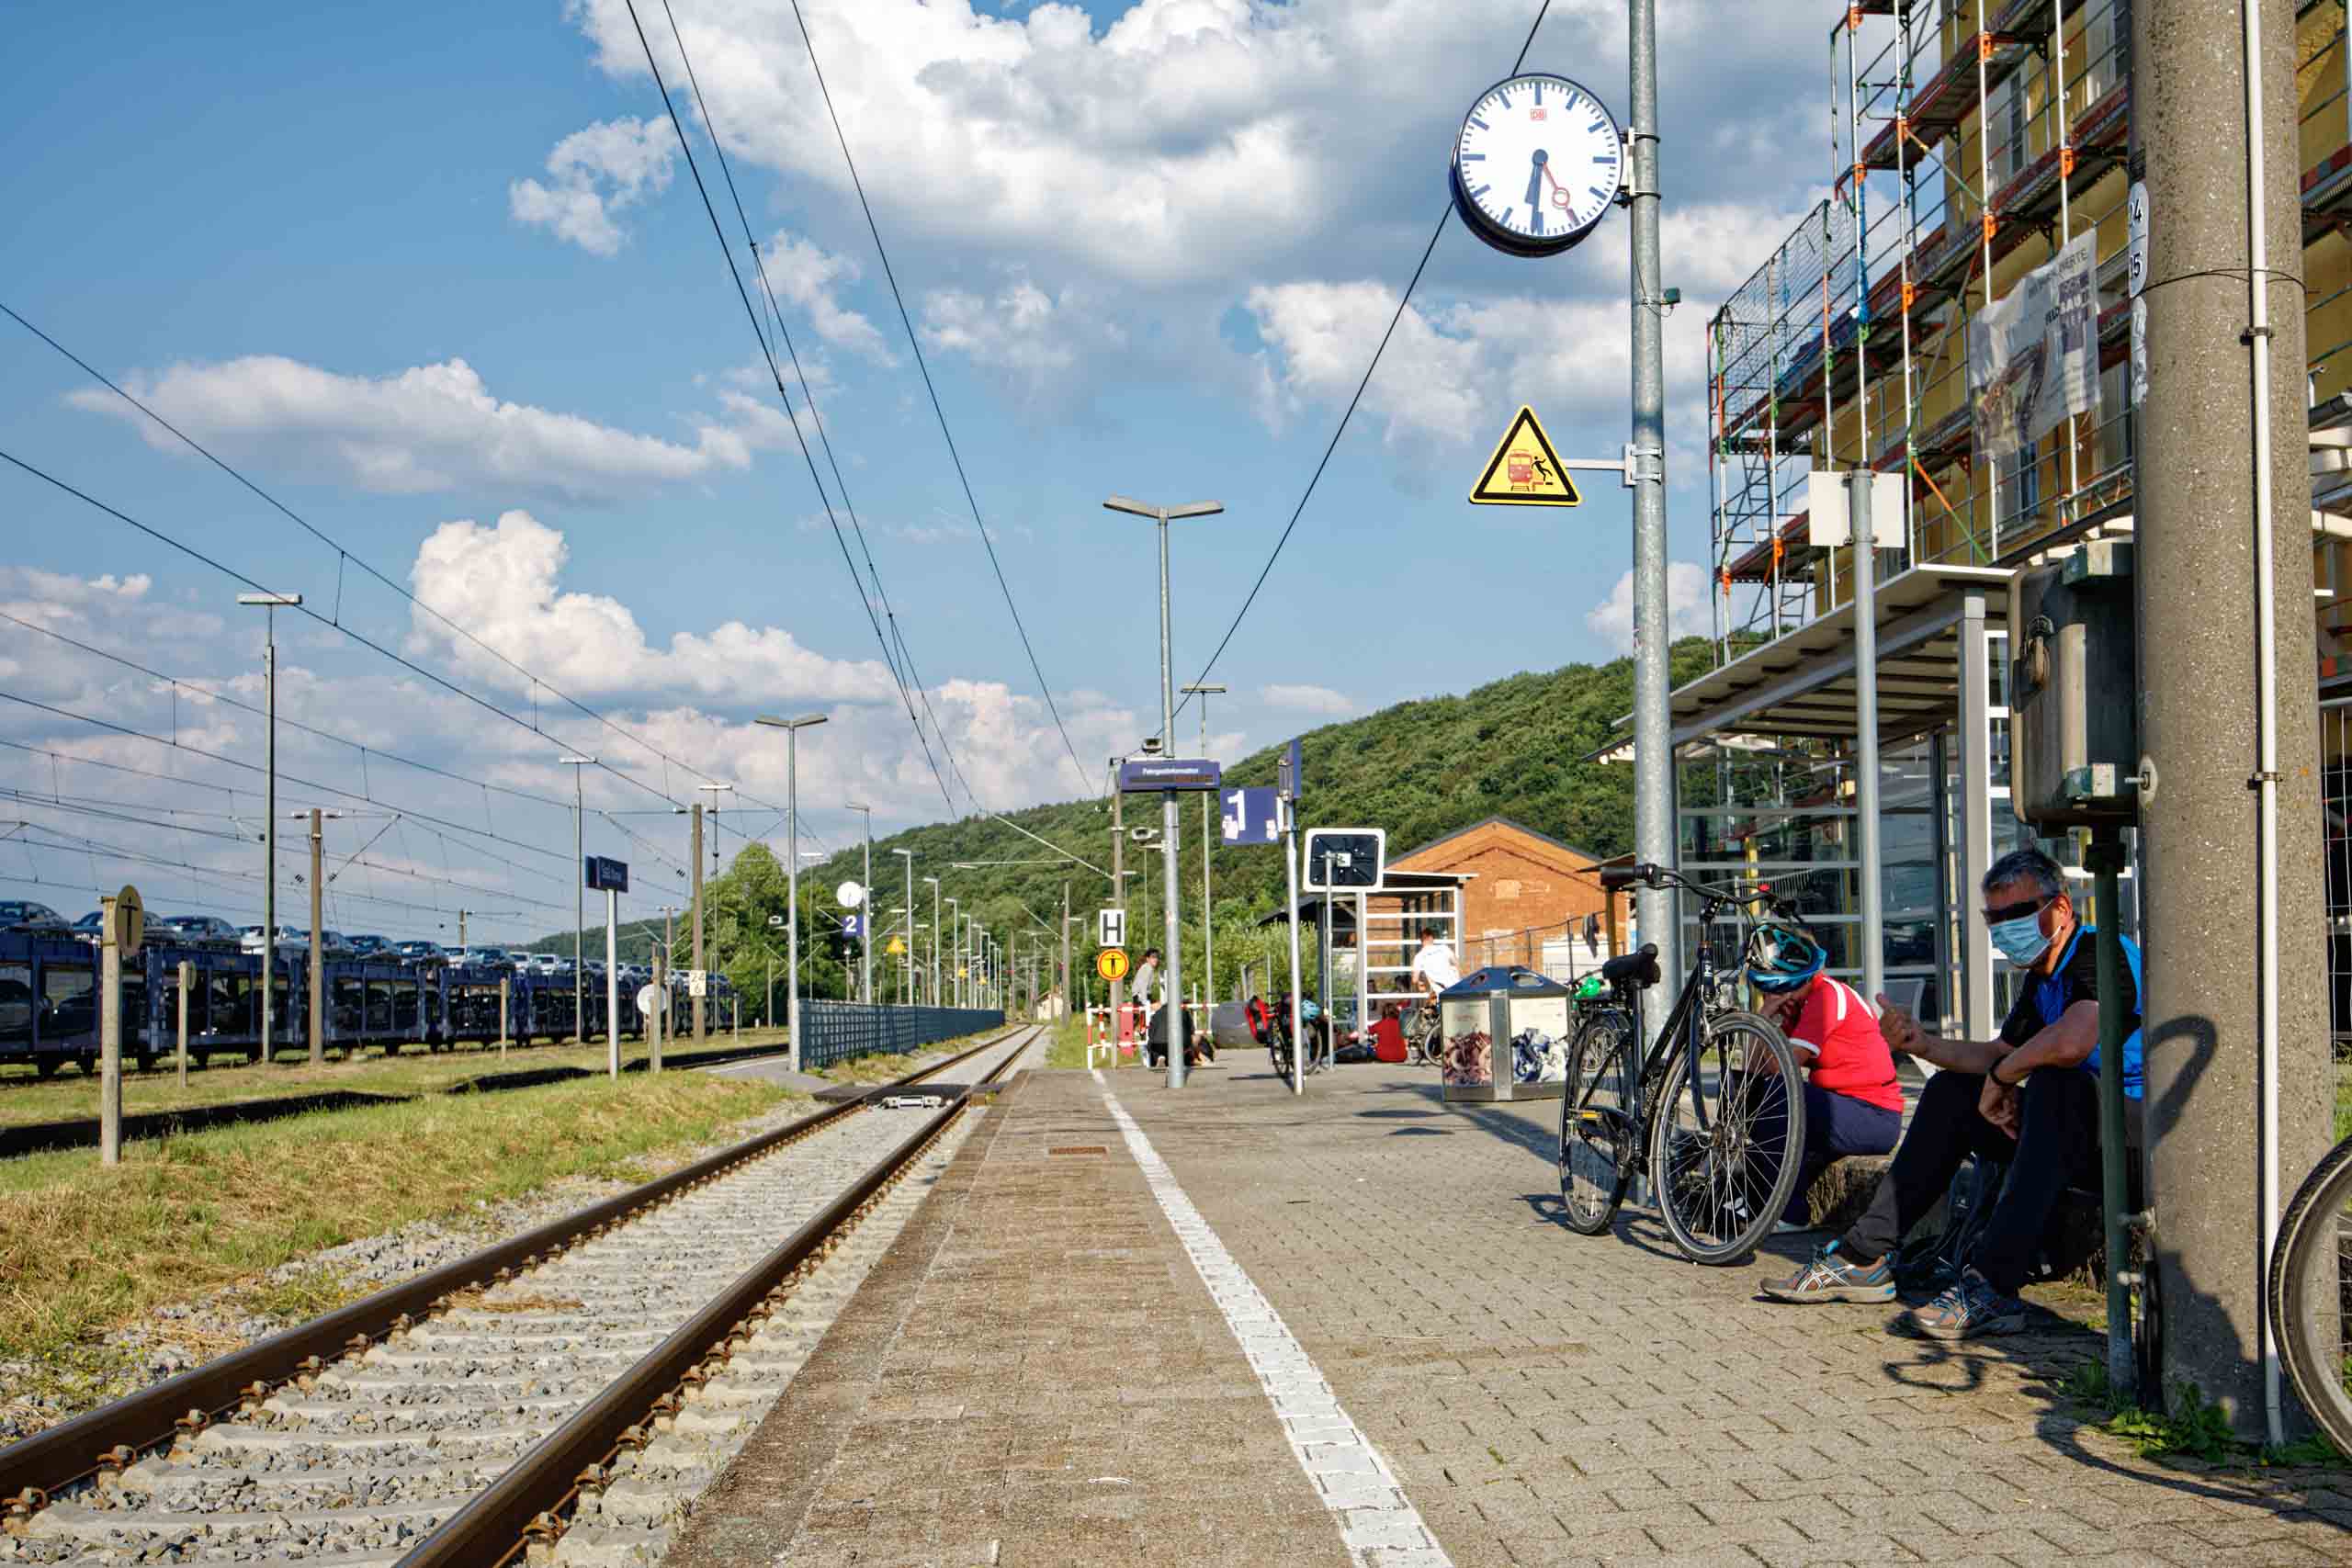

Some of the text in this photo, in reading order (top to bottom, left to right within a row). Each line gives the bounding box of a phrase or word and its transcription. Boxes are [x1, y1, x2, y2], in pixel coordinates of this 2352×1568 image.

[1227, 790, 1246, 831] 1
[845, 915, 857, 932] 2
[1102, 914, 1122, 942] H
